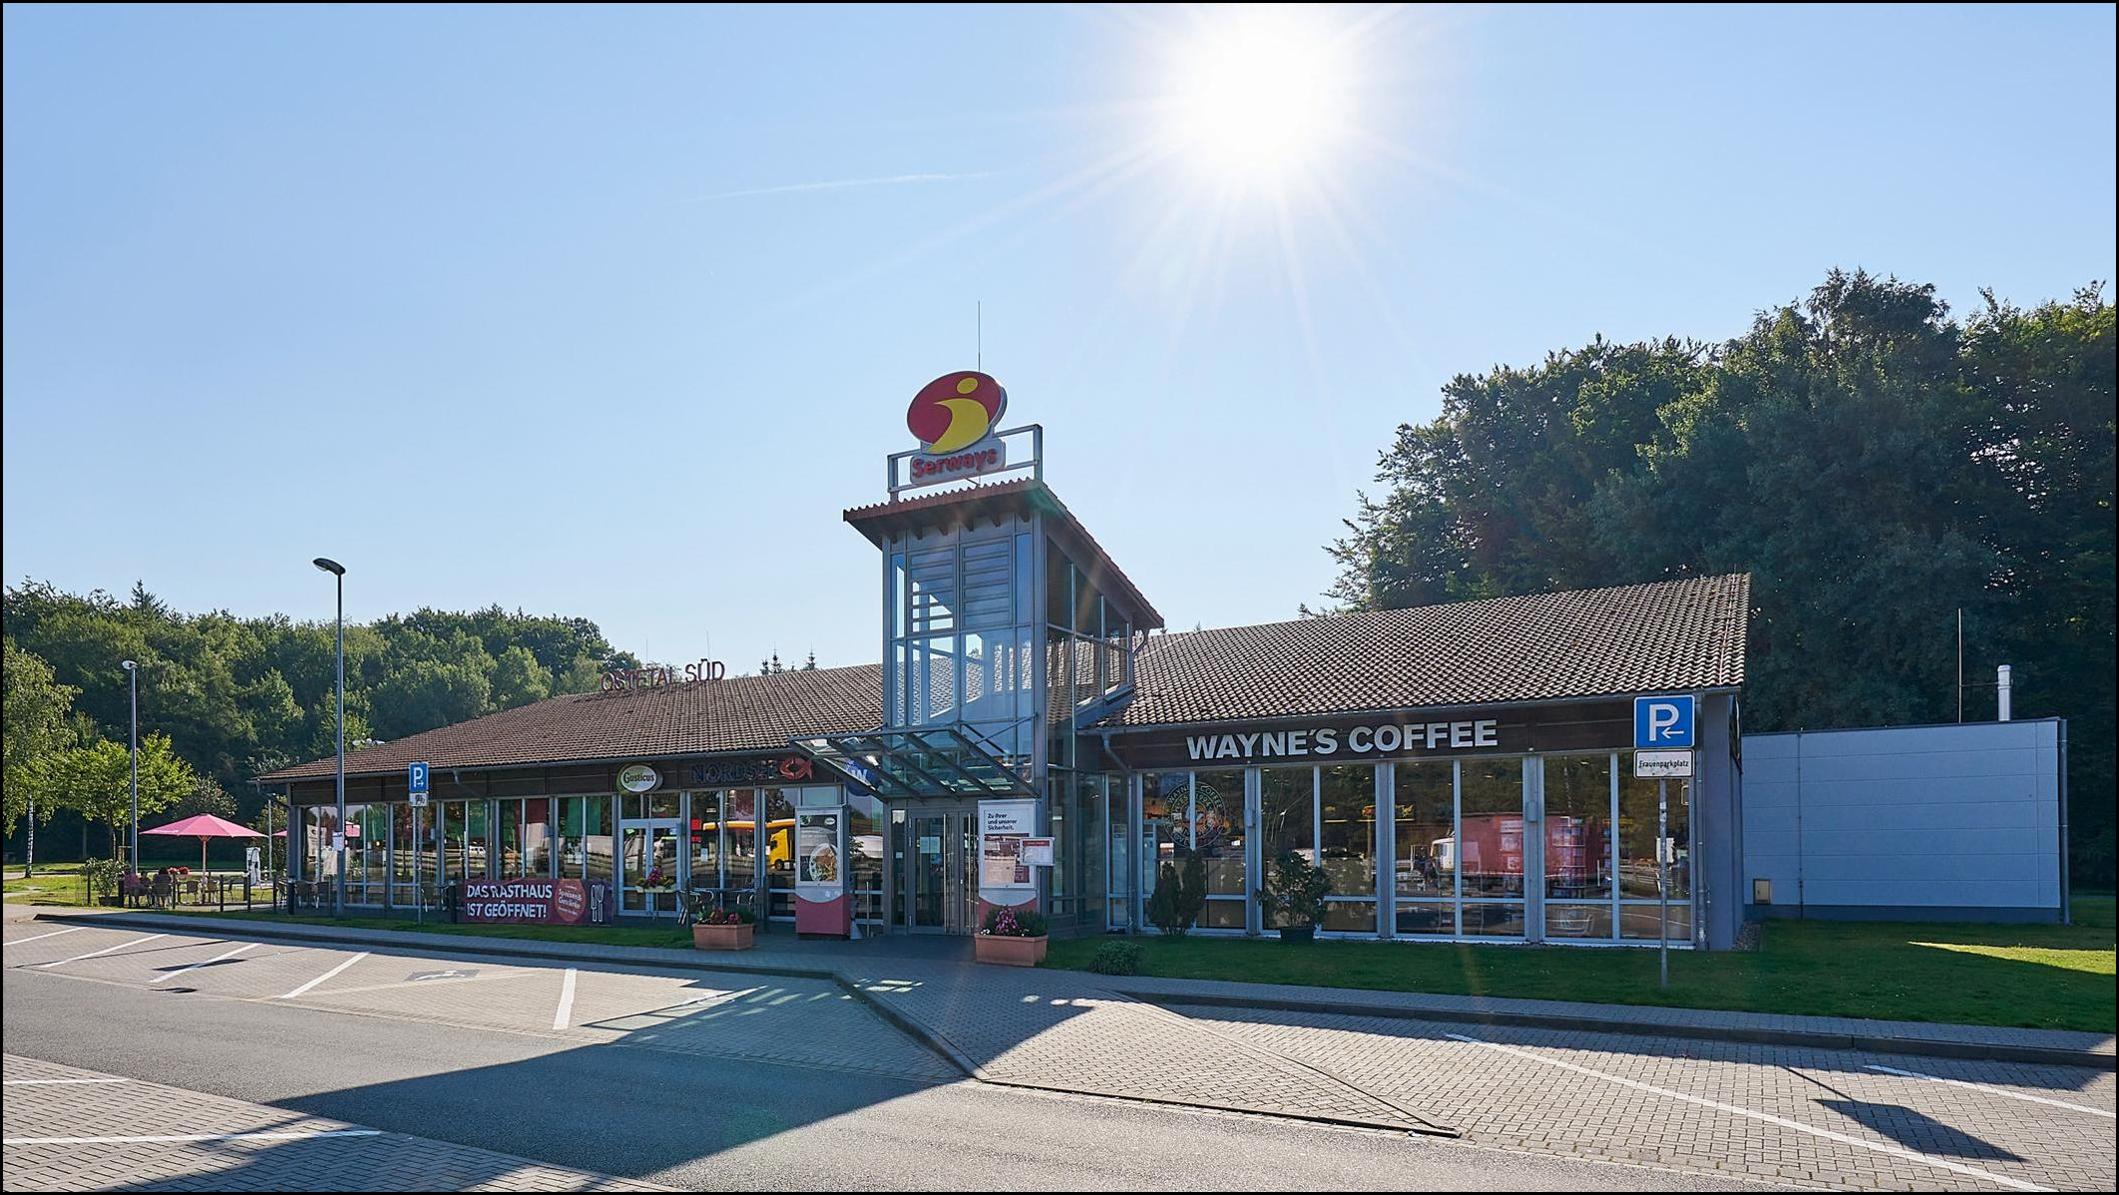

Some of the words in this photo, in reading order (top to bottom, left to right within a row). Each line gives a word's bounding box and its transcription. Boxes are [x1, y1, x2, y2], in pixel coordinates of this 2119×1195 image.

[912, 448, 998, 479] Serways
[684, 658, 726, 683] SÜD
[1648, 703, 1680, 742] P
[1185, 727, 1339, 760] WAYNE'S
[1348, 719, 1499, 753] COFFEE
[1638, 759, 1690, 770] Frauenparkplatz
[413, 766, 424, 788] P
[466, 884, 490, 899] DAS
[491, 884, 553, 899] RASTHAUS
[466, 902, 484, 917] IST
[484, 900, 547, 918] GEÖFFNET!
